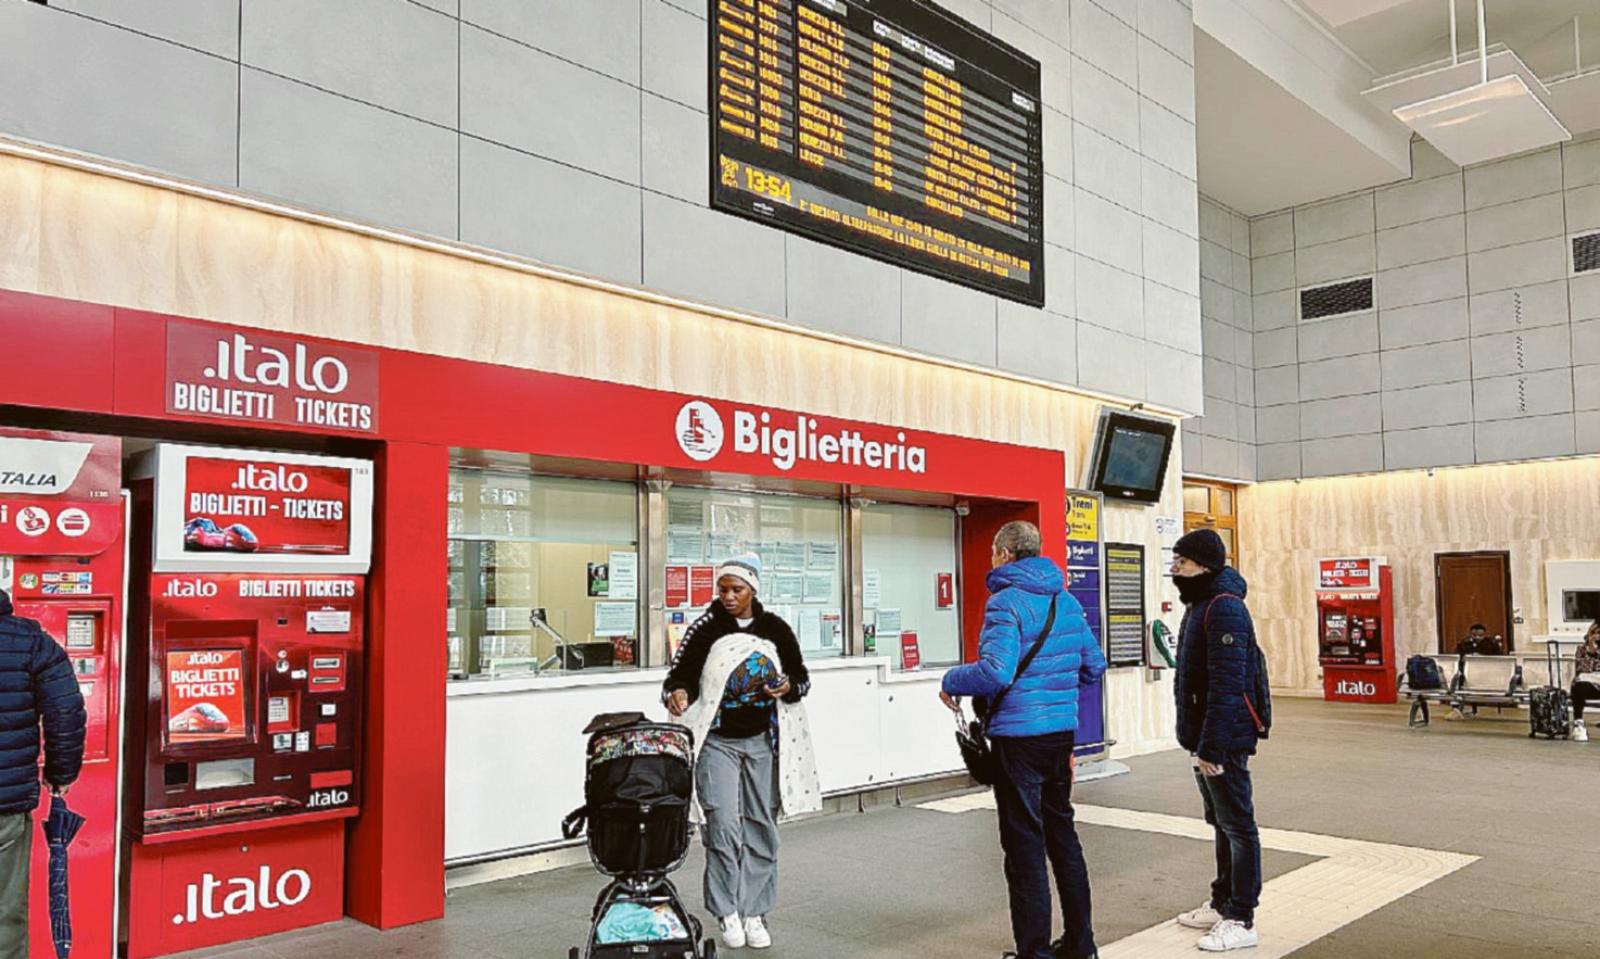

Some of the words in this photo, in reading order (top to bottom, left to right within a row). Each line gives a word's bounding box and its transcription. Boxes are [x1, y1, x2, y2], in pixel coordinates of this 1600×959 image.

[745, 166, 793, 203] 13:54
[173, 382, 274, 419] BIGLIETTI
[295, 397, 372, 429] TICKETS
[733, 410, 926, 473] Biglietteria
[190, 493, 267, 516] BIGLIETTI
[283, 499, 344, 520] TICKETS
[239, 580, 301, 597] BIGLIETTI
[304, 580, 355, 597] TICKETS
[940, 581, 948, 599] 1
[170, 668, 240, 684] BIGLIETTI
[175, 683, 236, 698] TICKETS
